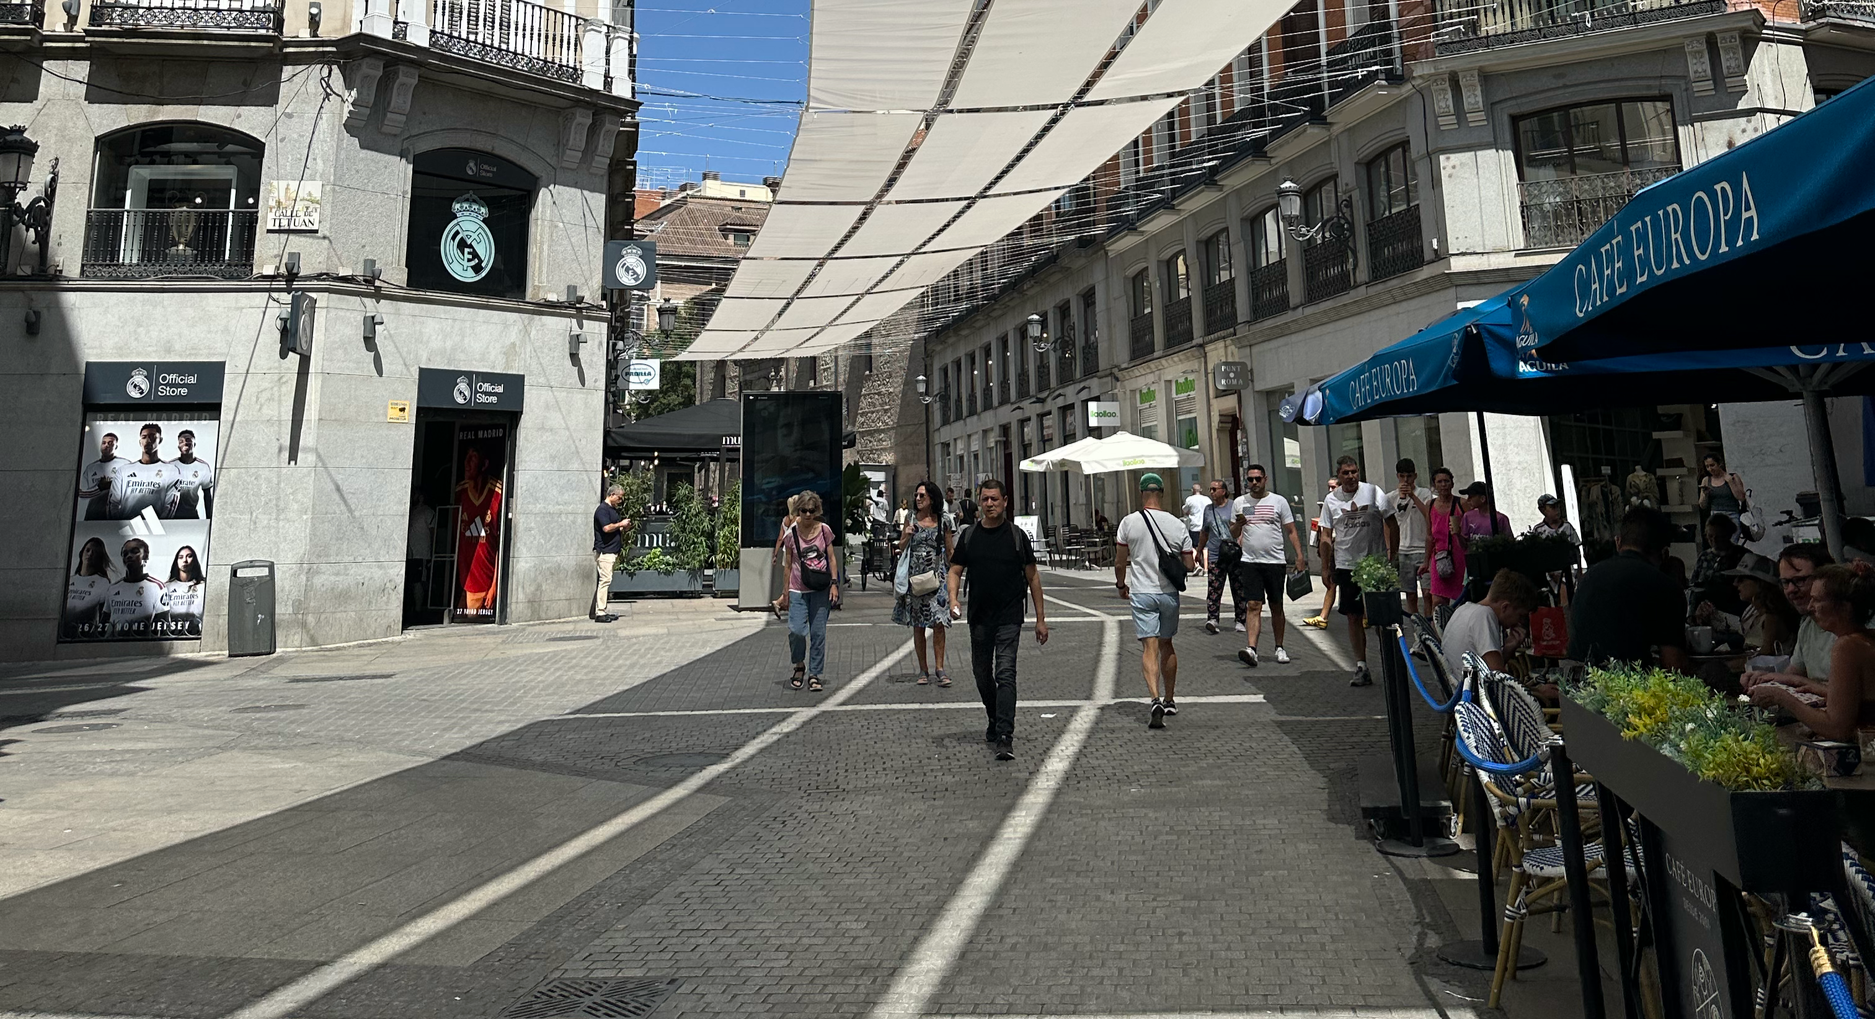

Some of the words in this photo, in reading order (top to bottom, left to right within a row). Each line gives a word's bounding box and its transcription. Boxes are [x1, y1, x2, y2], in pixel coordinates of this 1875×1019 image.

[274, 209, 301, 218] CALLE
[1574, 220, 1627, 318] CAFÉ
[1629, 170, 1760, 286] EUROPA
[159, 373, 198, 384] Official
[1349, 364, 1372, 410] CAFÉ
[1372, 357, 1418, 400] EUROPA
[157, 385, 188, 396] Store
[476, 382, 504, 393] Official
[475, 393, 498, 403] Store
[96, 413, 136, 425] REAL
[147, 412, 210, 425] MADRID
[459, 431, 475, 440] REAL
[477, 428, 504, 439] MADRID
[127, 479, 161, 489] Emirates
[111, 599, 143, 608] Emirates
[78, 623, 109, 634] 26/27
[115, 622, 146, 631] HOME
[151, 621, 189, 630] JERSEY
[1665, 852, 1687, 887] CAFÉ
[1686, 868, 1717, 912] EUROP
